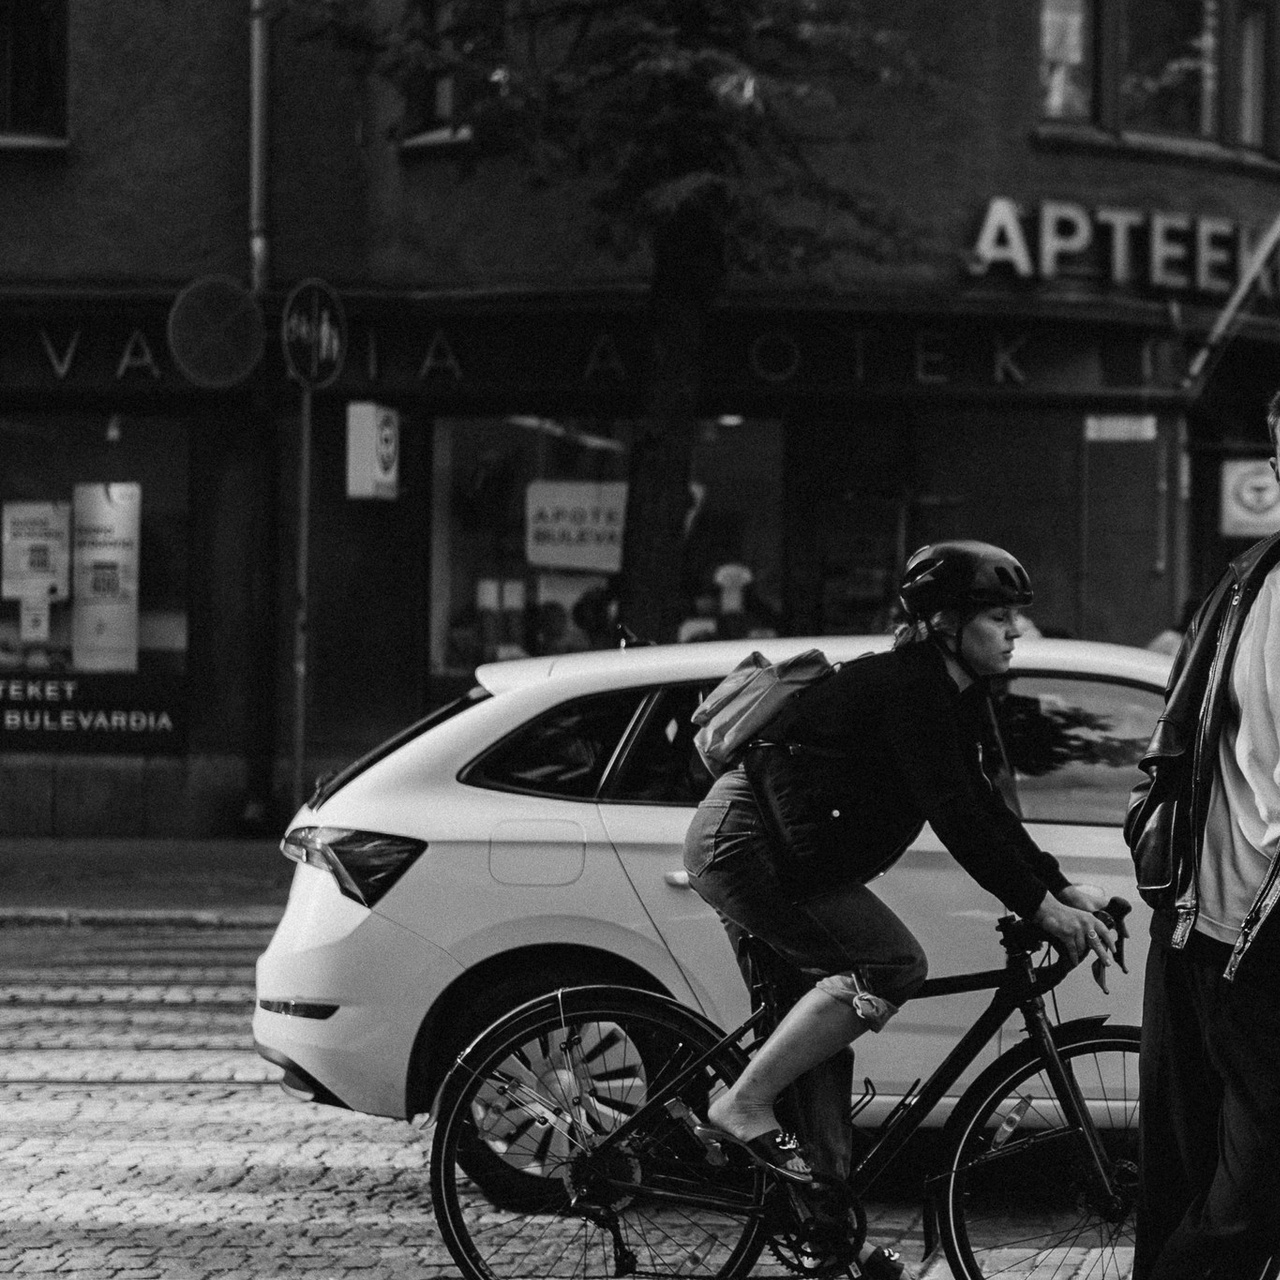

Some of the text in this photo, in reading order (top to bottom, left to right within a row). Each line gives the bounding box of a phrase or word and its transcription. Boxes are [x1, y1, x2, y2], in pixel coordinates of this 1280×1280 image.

[40, 328, 1025, 384] VAIA AOTEK
[3, 709, 173, 732] BULEVARDIA
